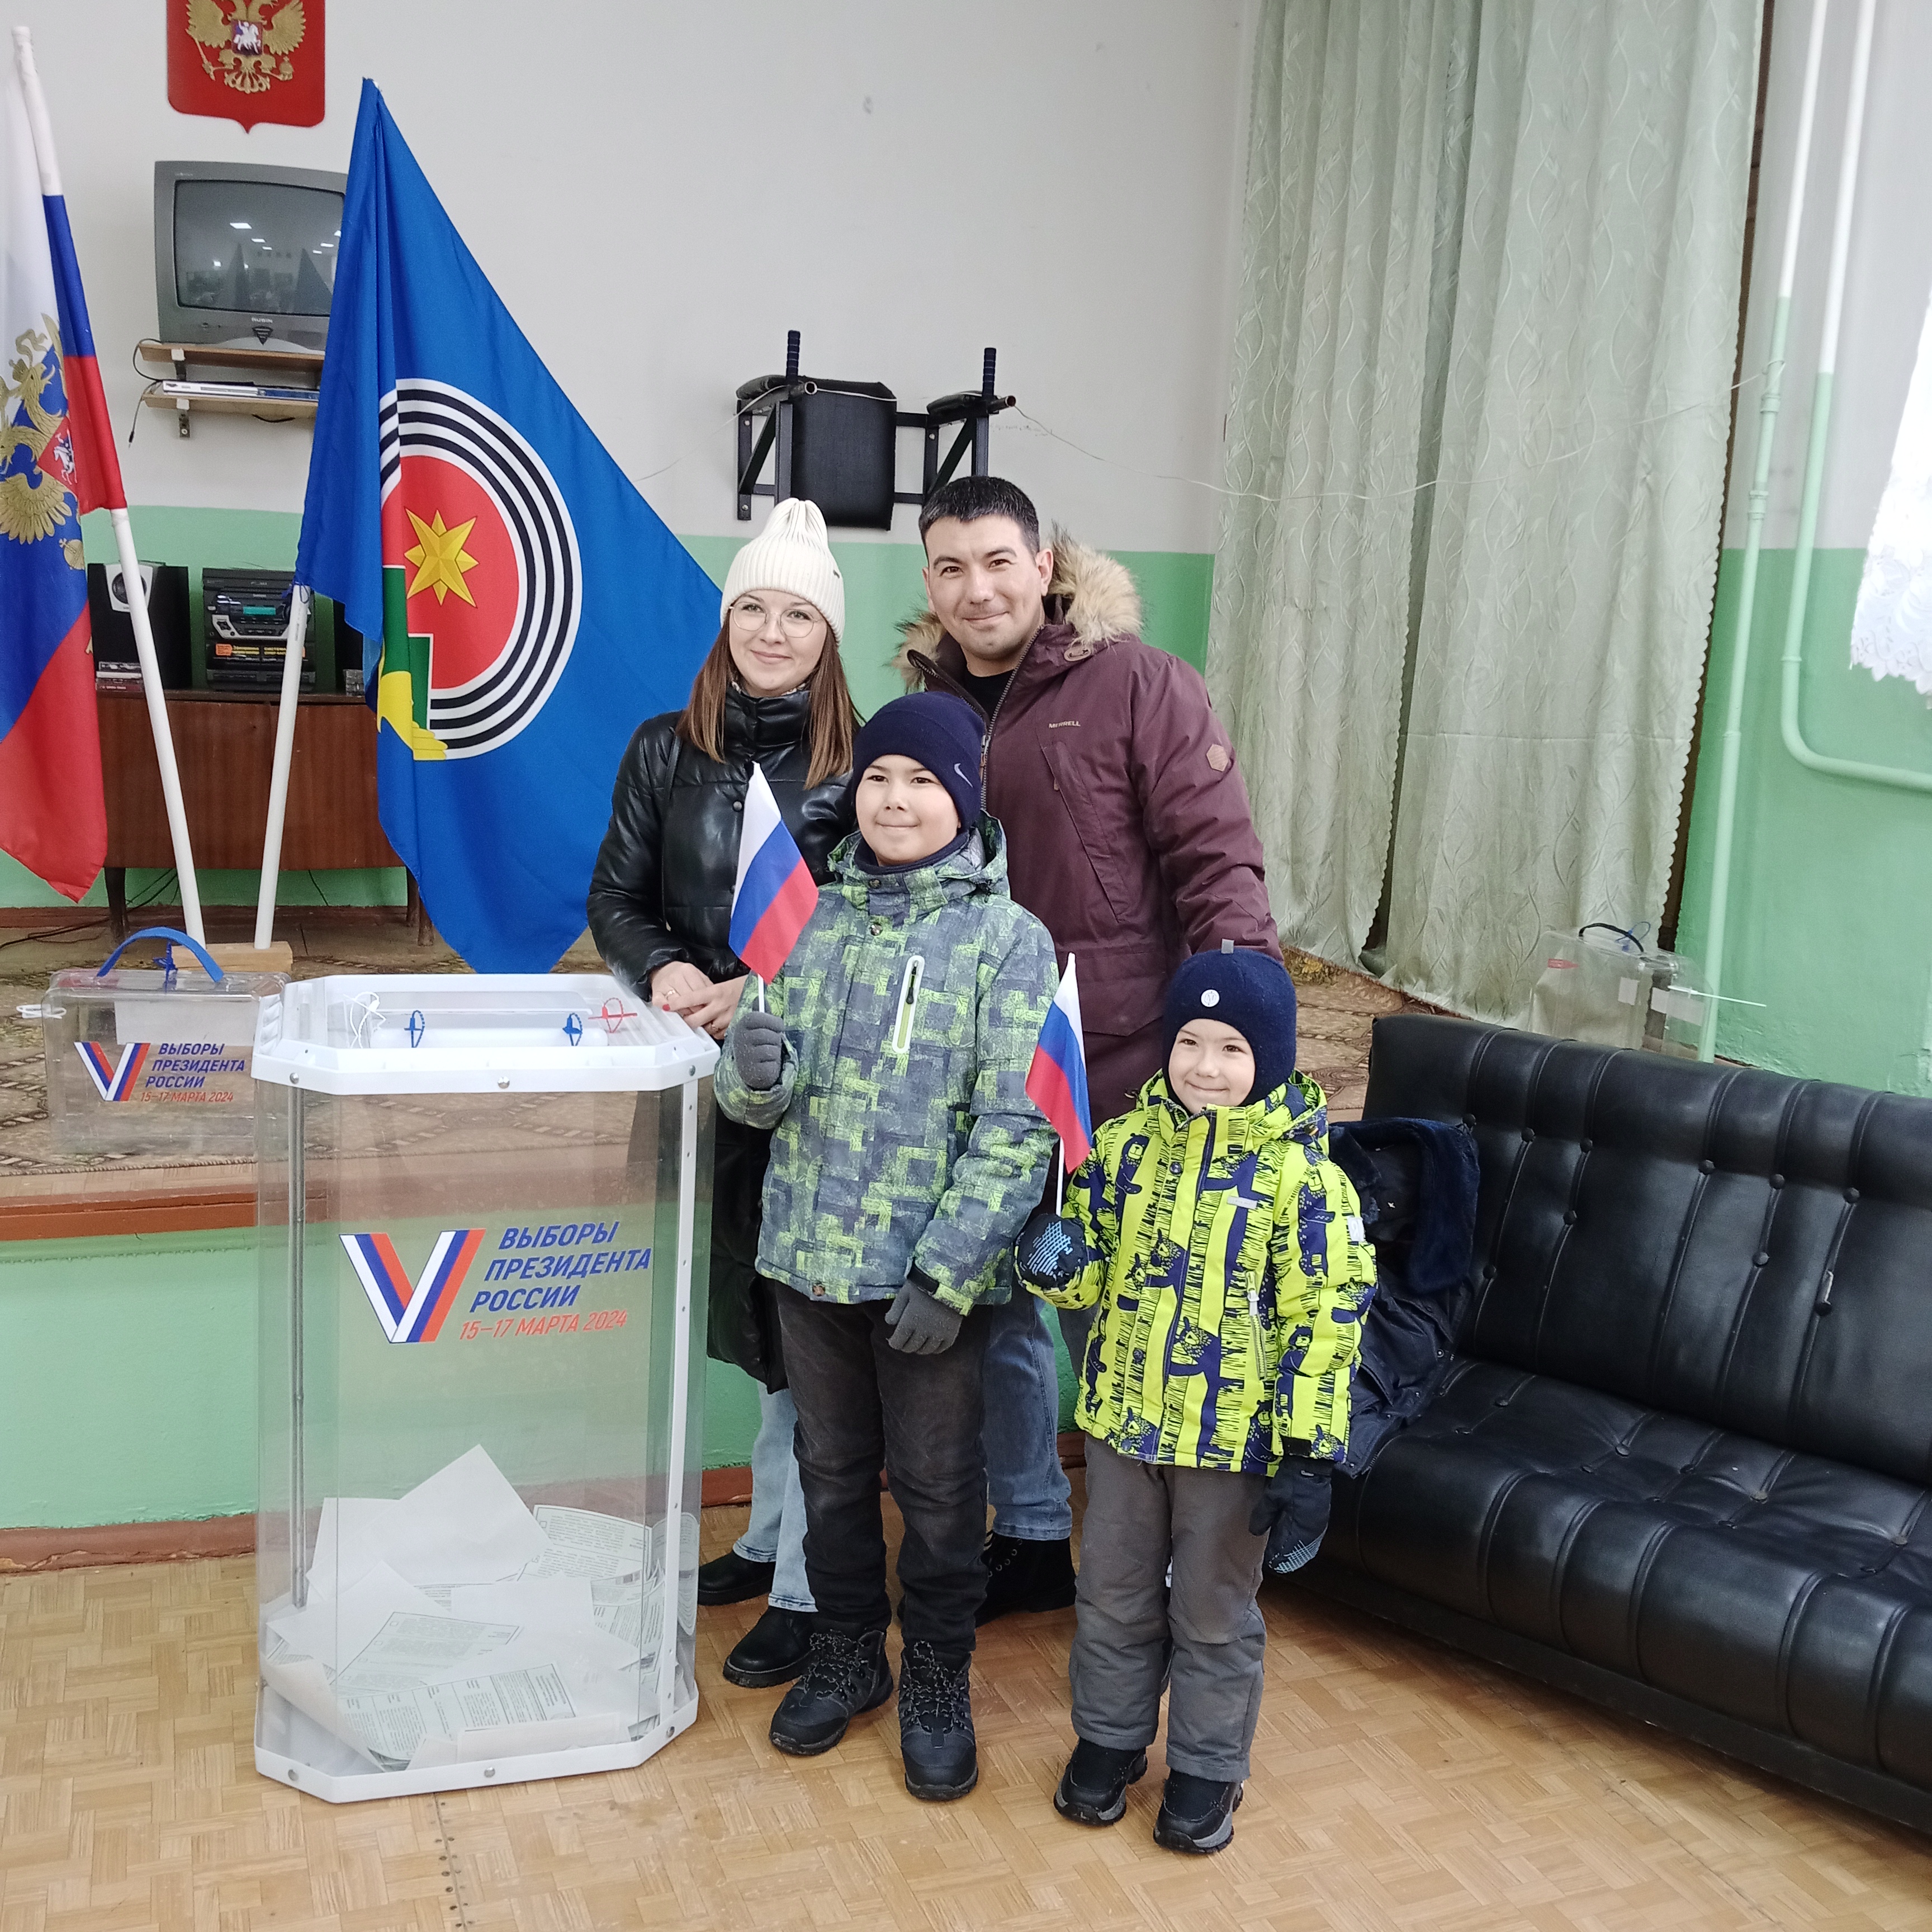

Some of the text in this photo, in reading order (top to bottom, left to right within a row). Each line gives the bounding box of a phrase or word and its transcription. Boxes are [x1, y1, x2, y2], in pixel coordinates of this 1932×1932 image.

[158, 1043, 225, 1055] ВЫБОРЫ
[151, 1059, 245, 1073] ПРЕЗИДЕНТА
[145, 1076, 205, 1088] РОССИИ
[171, 1092, 206, 1102] МАРТА
[209, 1092, 234, 1102] 2024
[499, 1221, 620, 1250] ВЫБОРЫ
[484, 1248, 652, 1282] ПРЕЗИДЕНТА
[469, 1285, 581, 1313] РОССИИ
[514, 1314, 580, 1337] МАРТА
[583, 1309, 628, 1332] 2024
